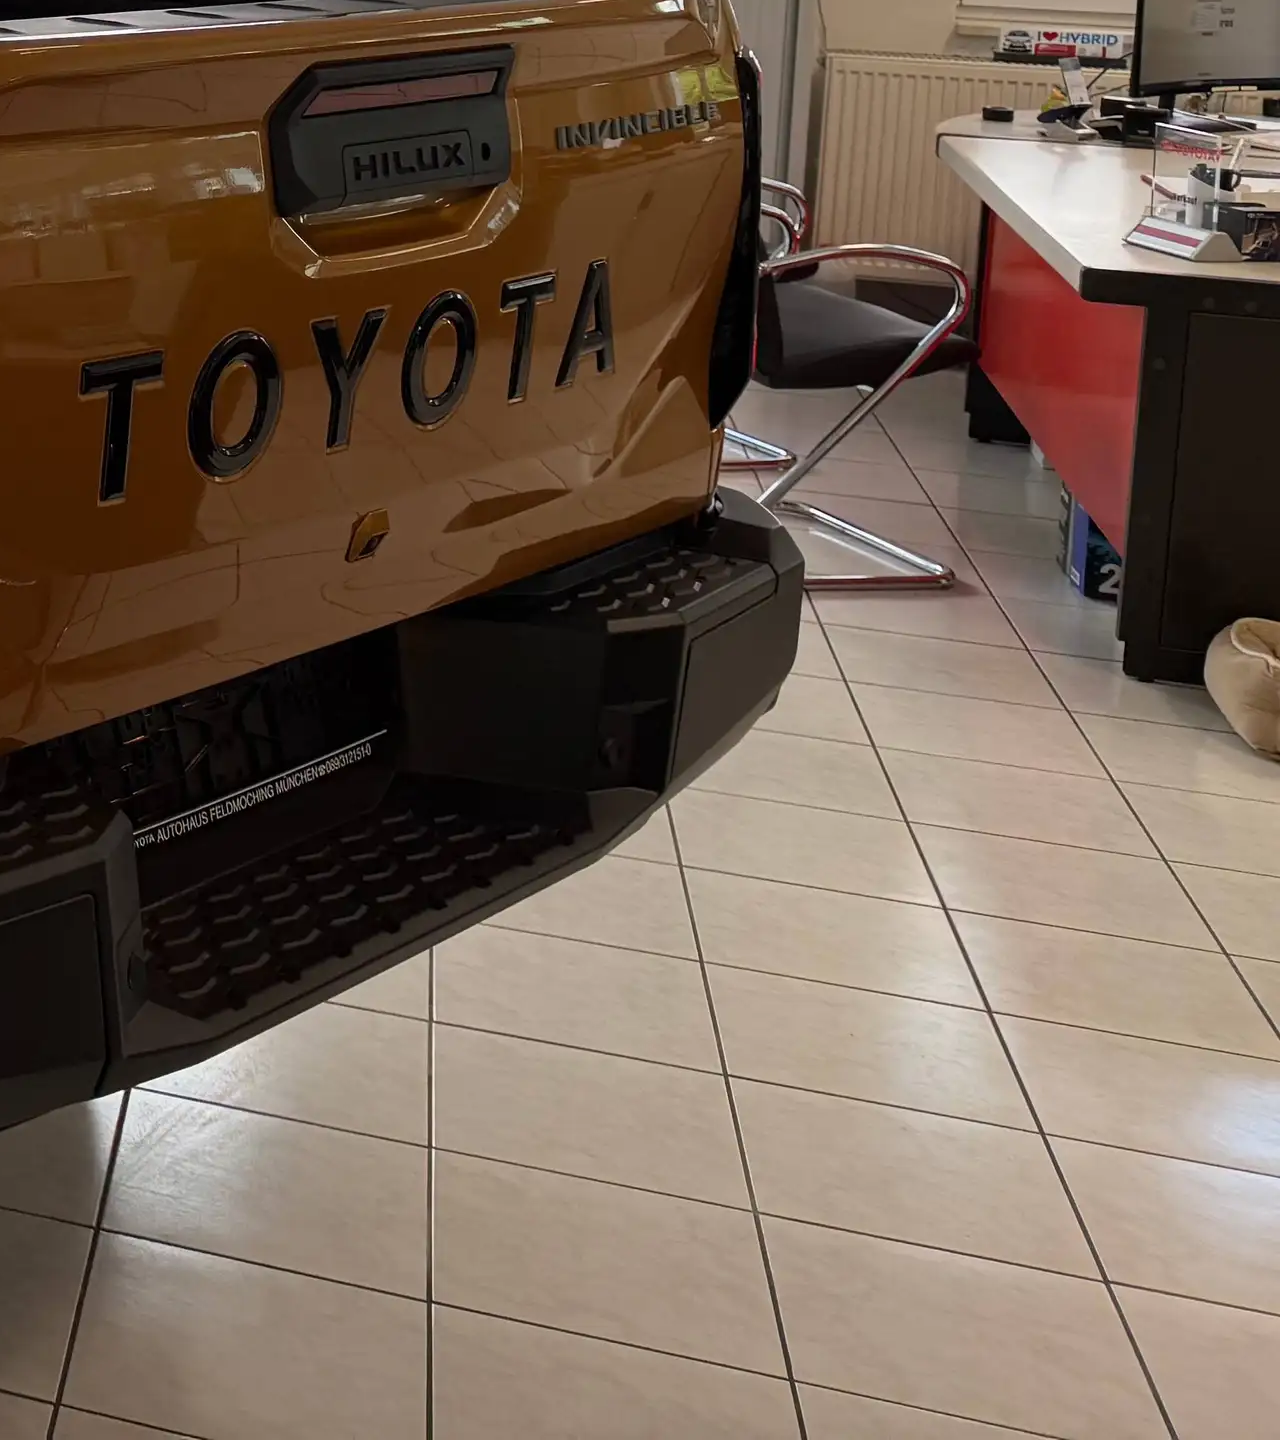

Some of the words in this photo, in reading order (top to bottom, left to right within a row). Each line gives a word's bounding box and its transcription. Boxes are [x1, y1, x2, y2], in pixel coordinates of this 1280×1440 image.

[1060, 32, 1118, 46] HYBRID
[554, 101, 722, 150] INVINCIBLE
[354, 142, 466, 182] HILUX
[78, 257, 616, 507] TOYOTA
[134, 834, 155, 849] YOTA
[157, 811, 209, 844] AUTOHAUS
[210, 783, 275, 823] FELDMOCHING
[276, 766, 319, 796] MÜNCHEN
